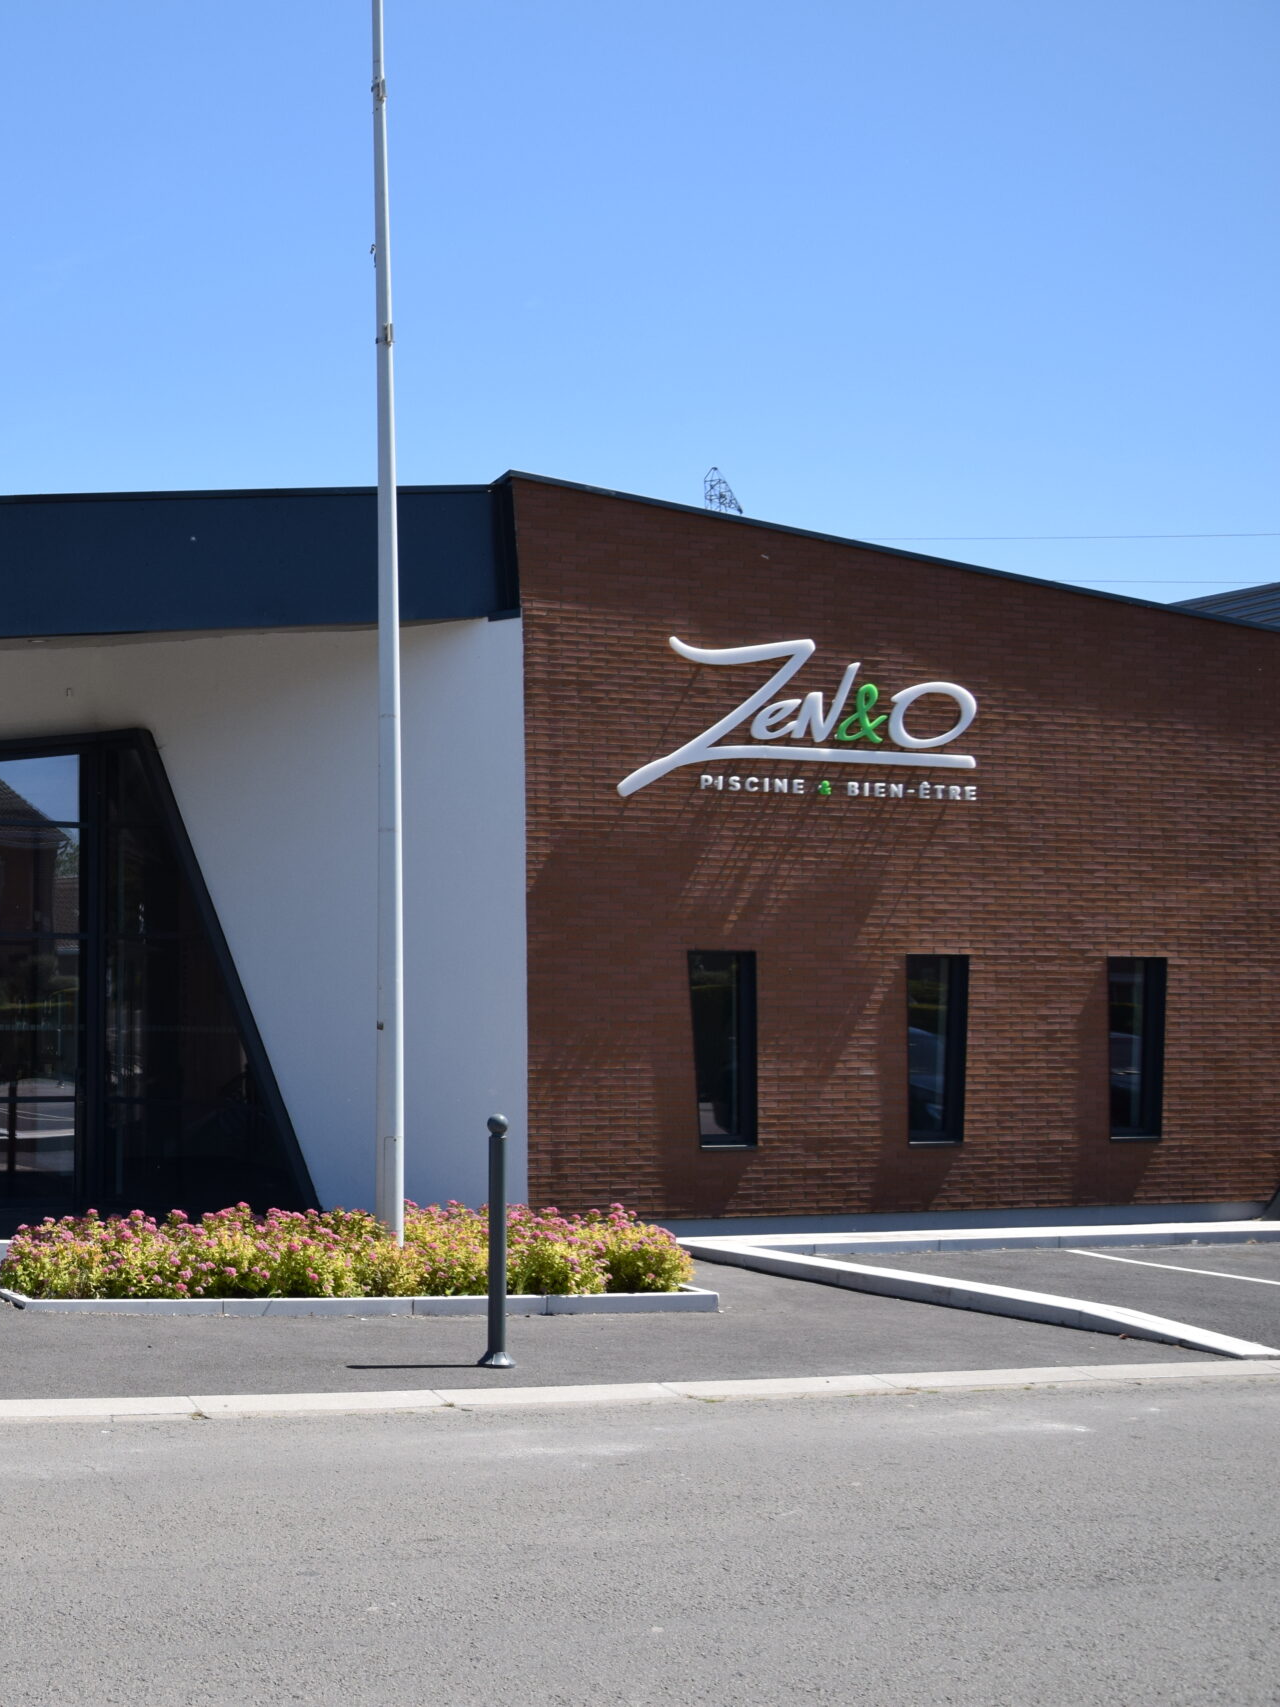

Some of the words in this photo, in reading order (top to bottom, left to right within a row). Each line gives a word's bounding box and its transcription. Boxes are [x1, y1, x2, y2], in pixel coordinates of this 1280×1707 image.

[699, 774, 805, 795] PISCINE
[819, 780, 832, 796] &
[846, 781, 978, 801] BIEN-ÊTRE
